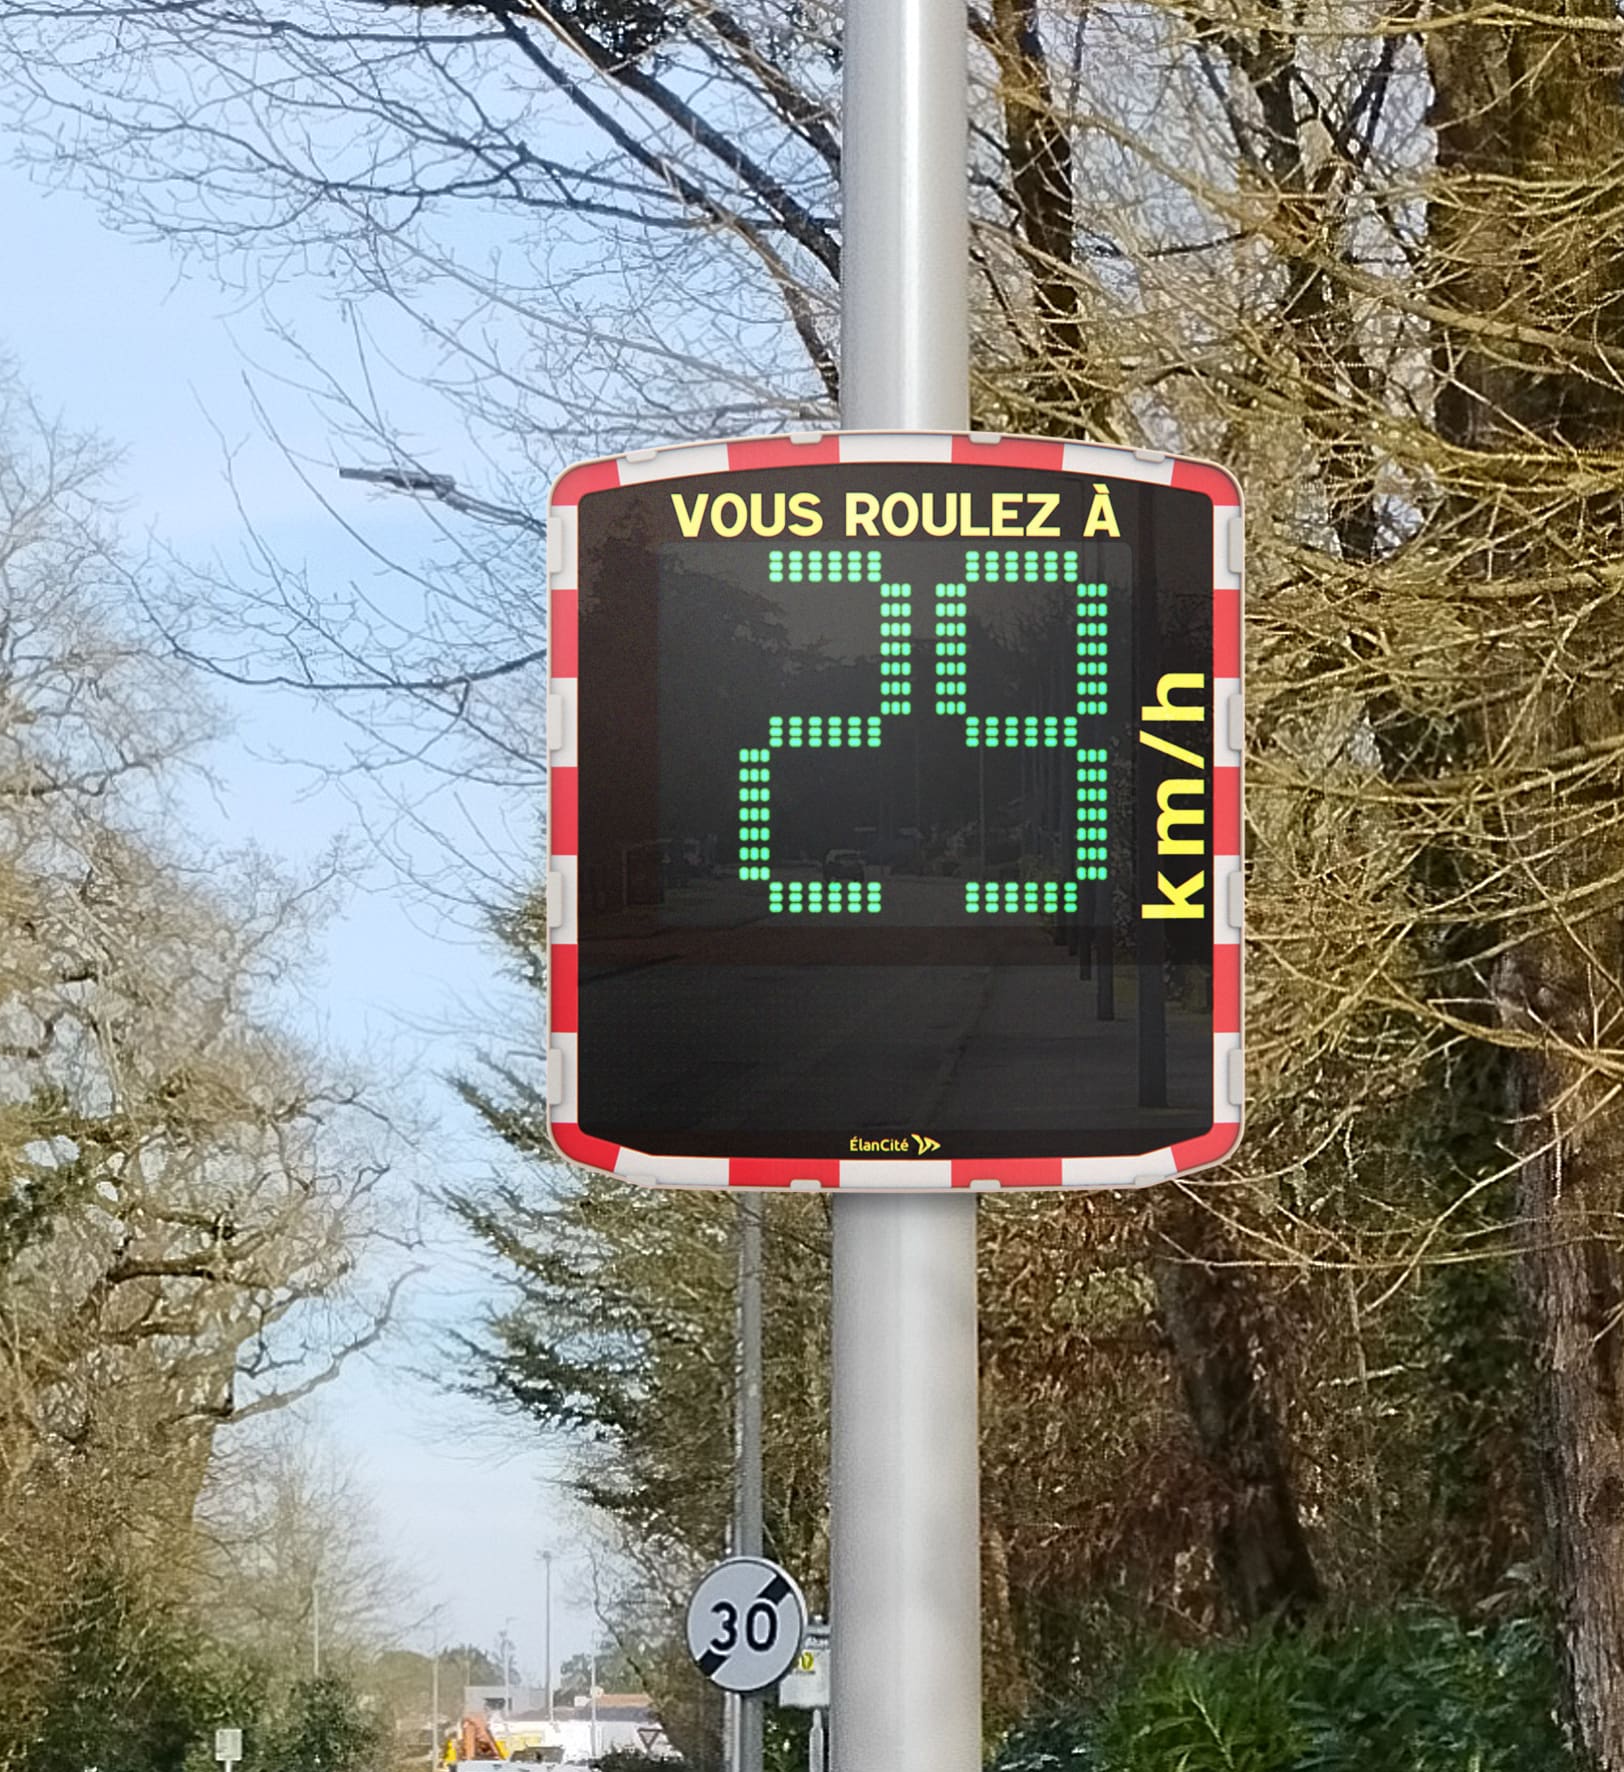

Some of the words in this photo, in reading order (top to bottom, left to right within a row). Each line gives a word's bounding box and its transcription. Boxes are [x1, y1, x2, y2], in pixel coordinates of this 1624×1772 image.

[671, 493, 823, 537] VOUS
[846, 492, 1060, 537] ROULEZ
[1084, 484, 1120, 537] À
[739, 550, 1108, 913] 29
[1140, 672, 1204, 918] km/h
[849, 1136, 909, 1152] ÉlanCité
[710, 1601, 777, 1652] 30
